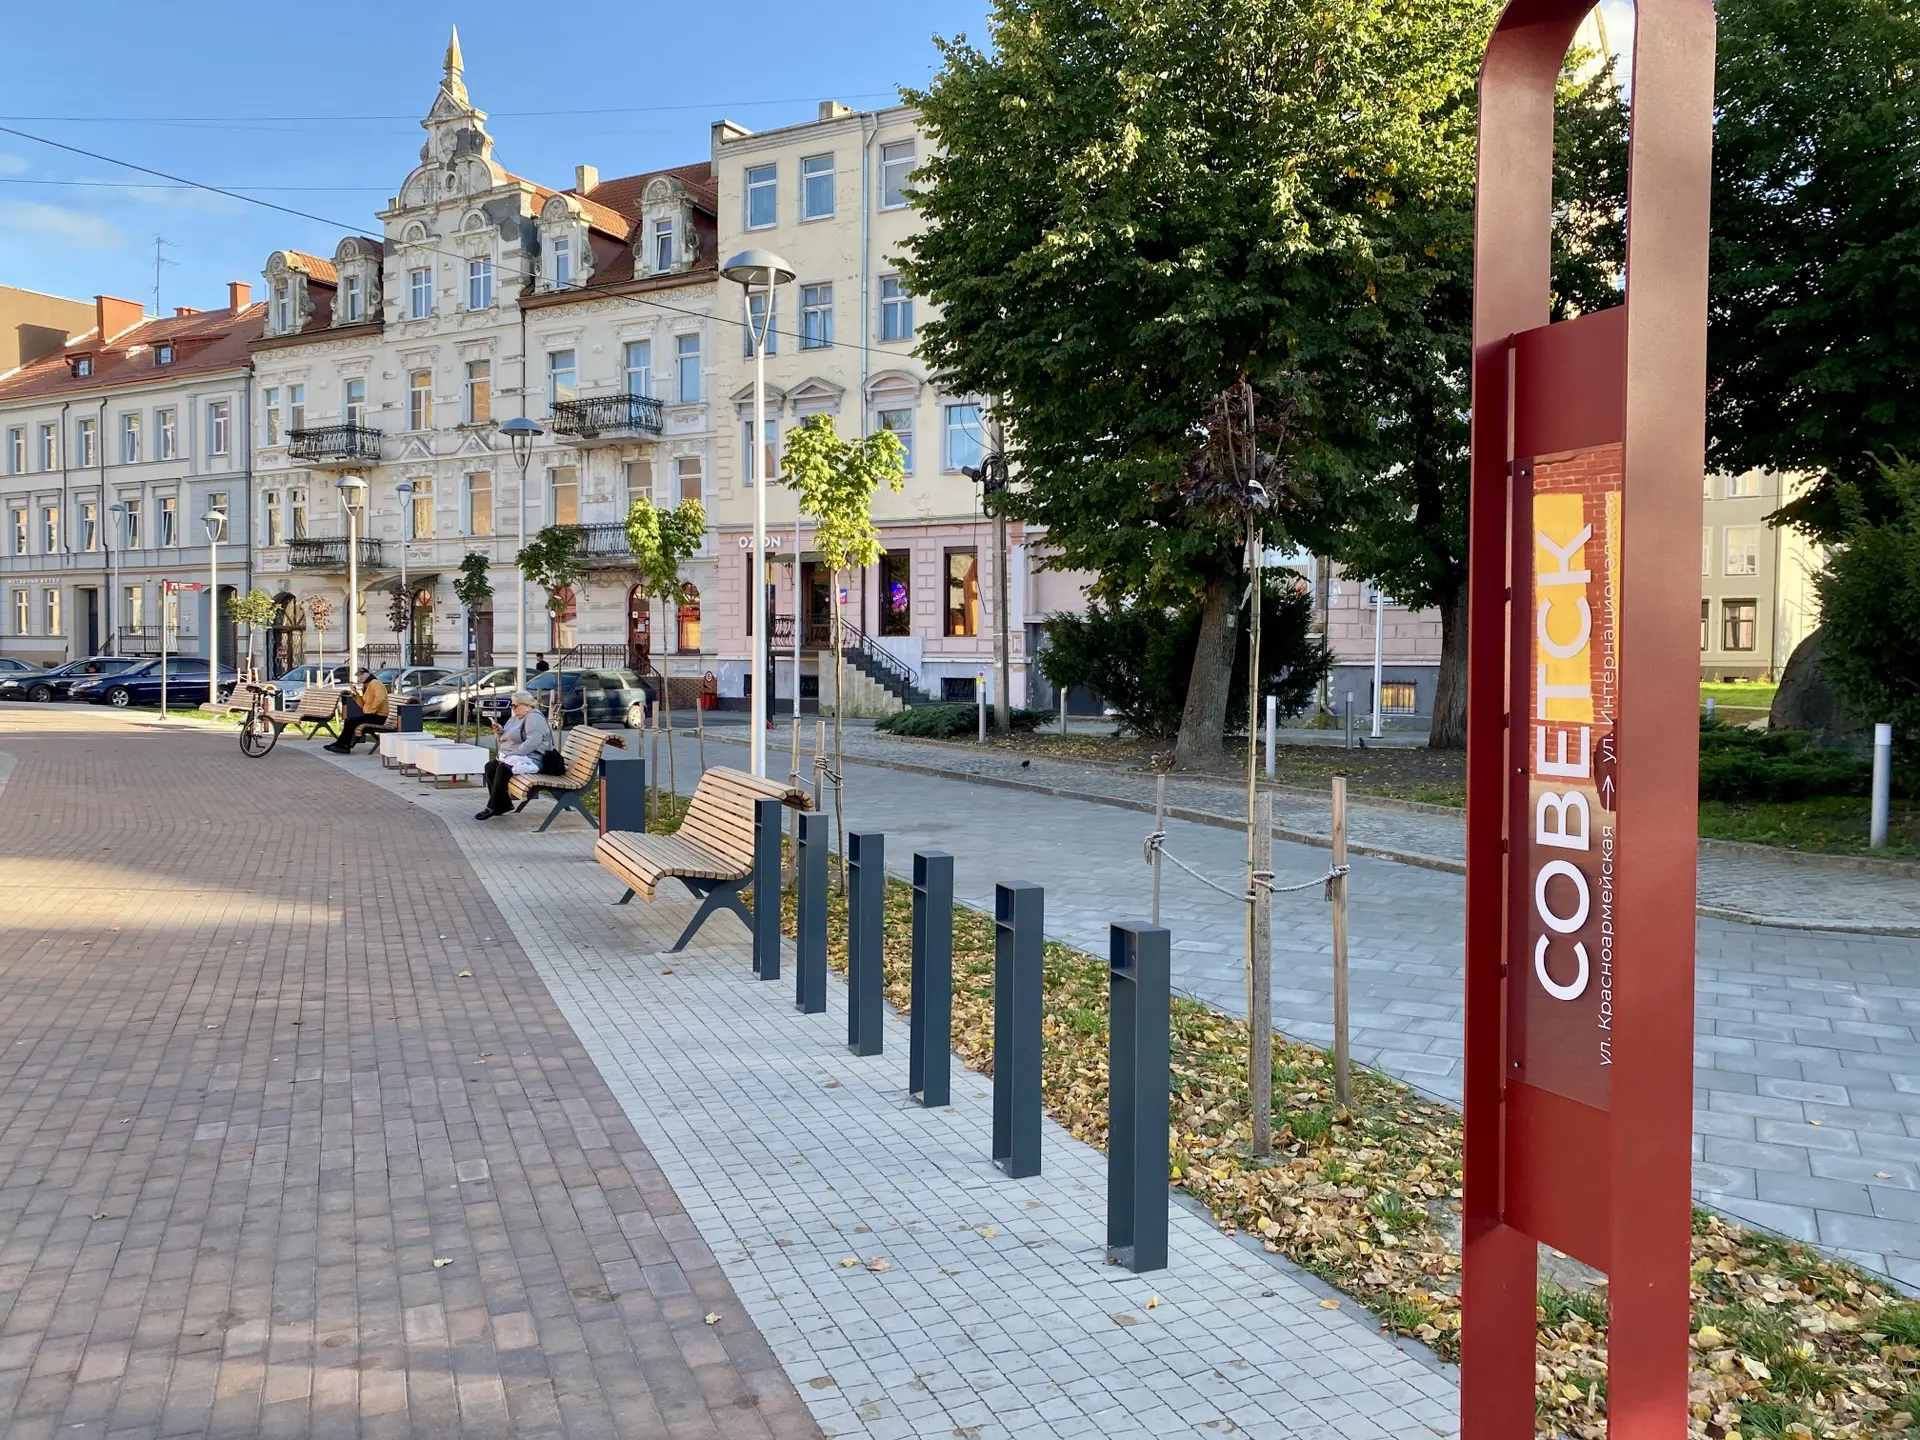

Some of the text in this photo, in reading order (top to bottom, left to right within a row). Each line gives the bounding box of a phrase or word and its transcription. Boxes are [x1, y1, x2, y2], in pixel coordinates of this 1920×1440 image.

[1534, 524, 1591, 1000] СОВЕТСК
[1598, 491, 1617, 1066] ул. Красноармейская ул. Интернациональная
